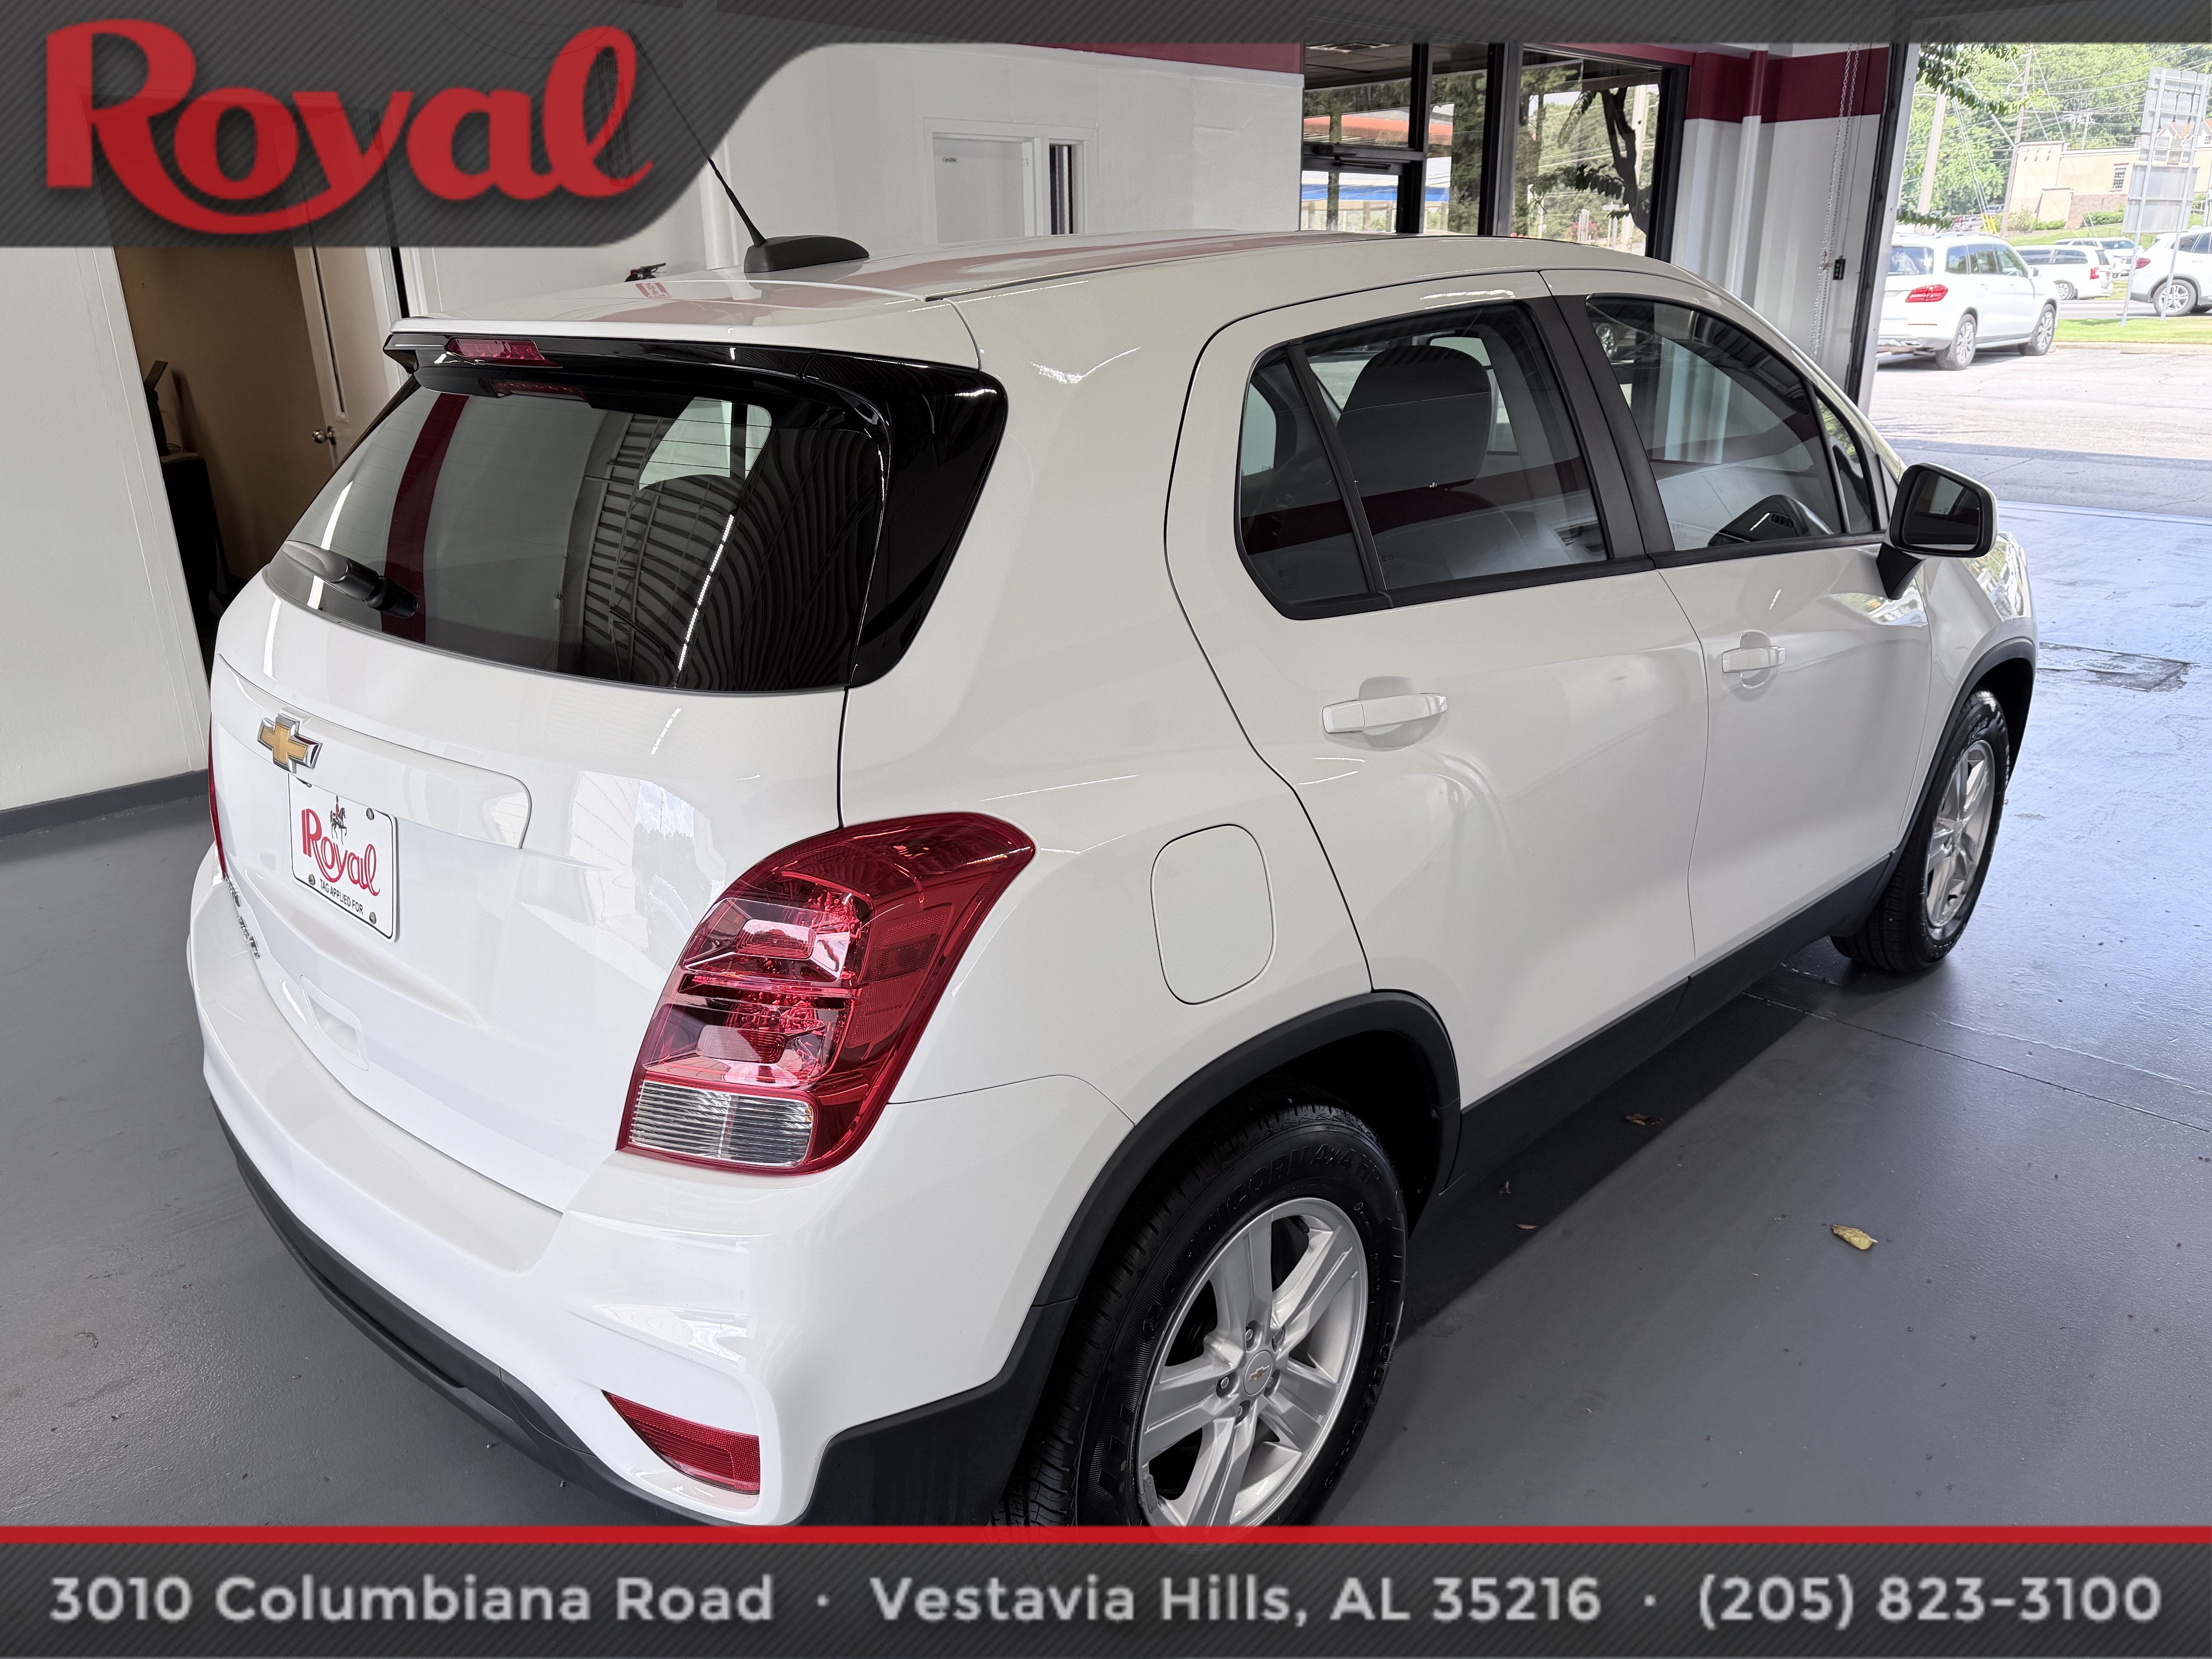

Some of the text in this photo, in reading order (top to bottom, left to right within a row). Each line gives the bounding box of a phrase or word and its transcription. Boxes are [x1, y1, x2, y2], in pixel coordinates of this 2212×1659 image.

[301, 808, 380, 896] Royal
[319, 879, 363, 915] TAG APPLIED FOR
